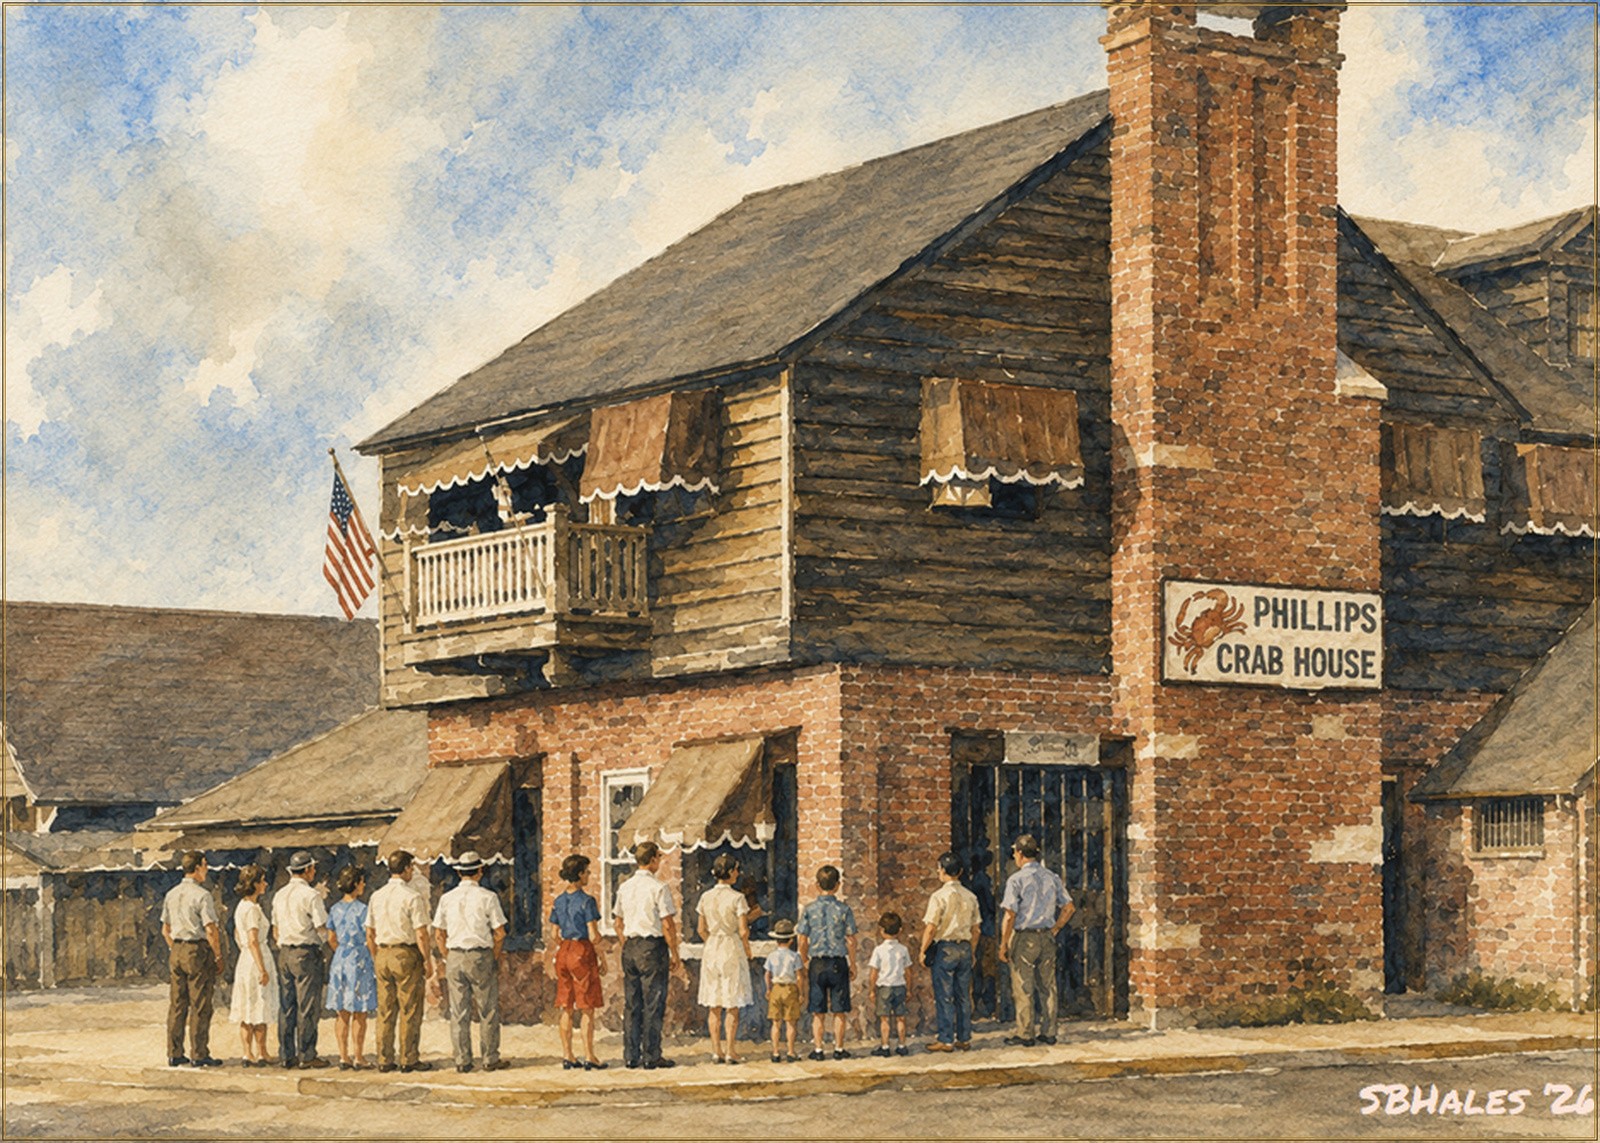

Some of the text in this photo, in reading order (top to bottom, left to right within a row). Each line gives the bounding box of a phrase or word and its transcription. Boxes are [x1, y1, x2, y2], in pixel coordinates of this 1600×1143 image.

[1254, 595, 1377, 633] PHILLIPS
[1216, 643, 1376, 680] CRAB HOUSE
